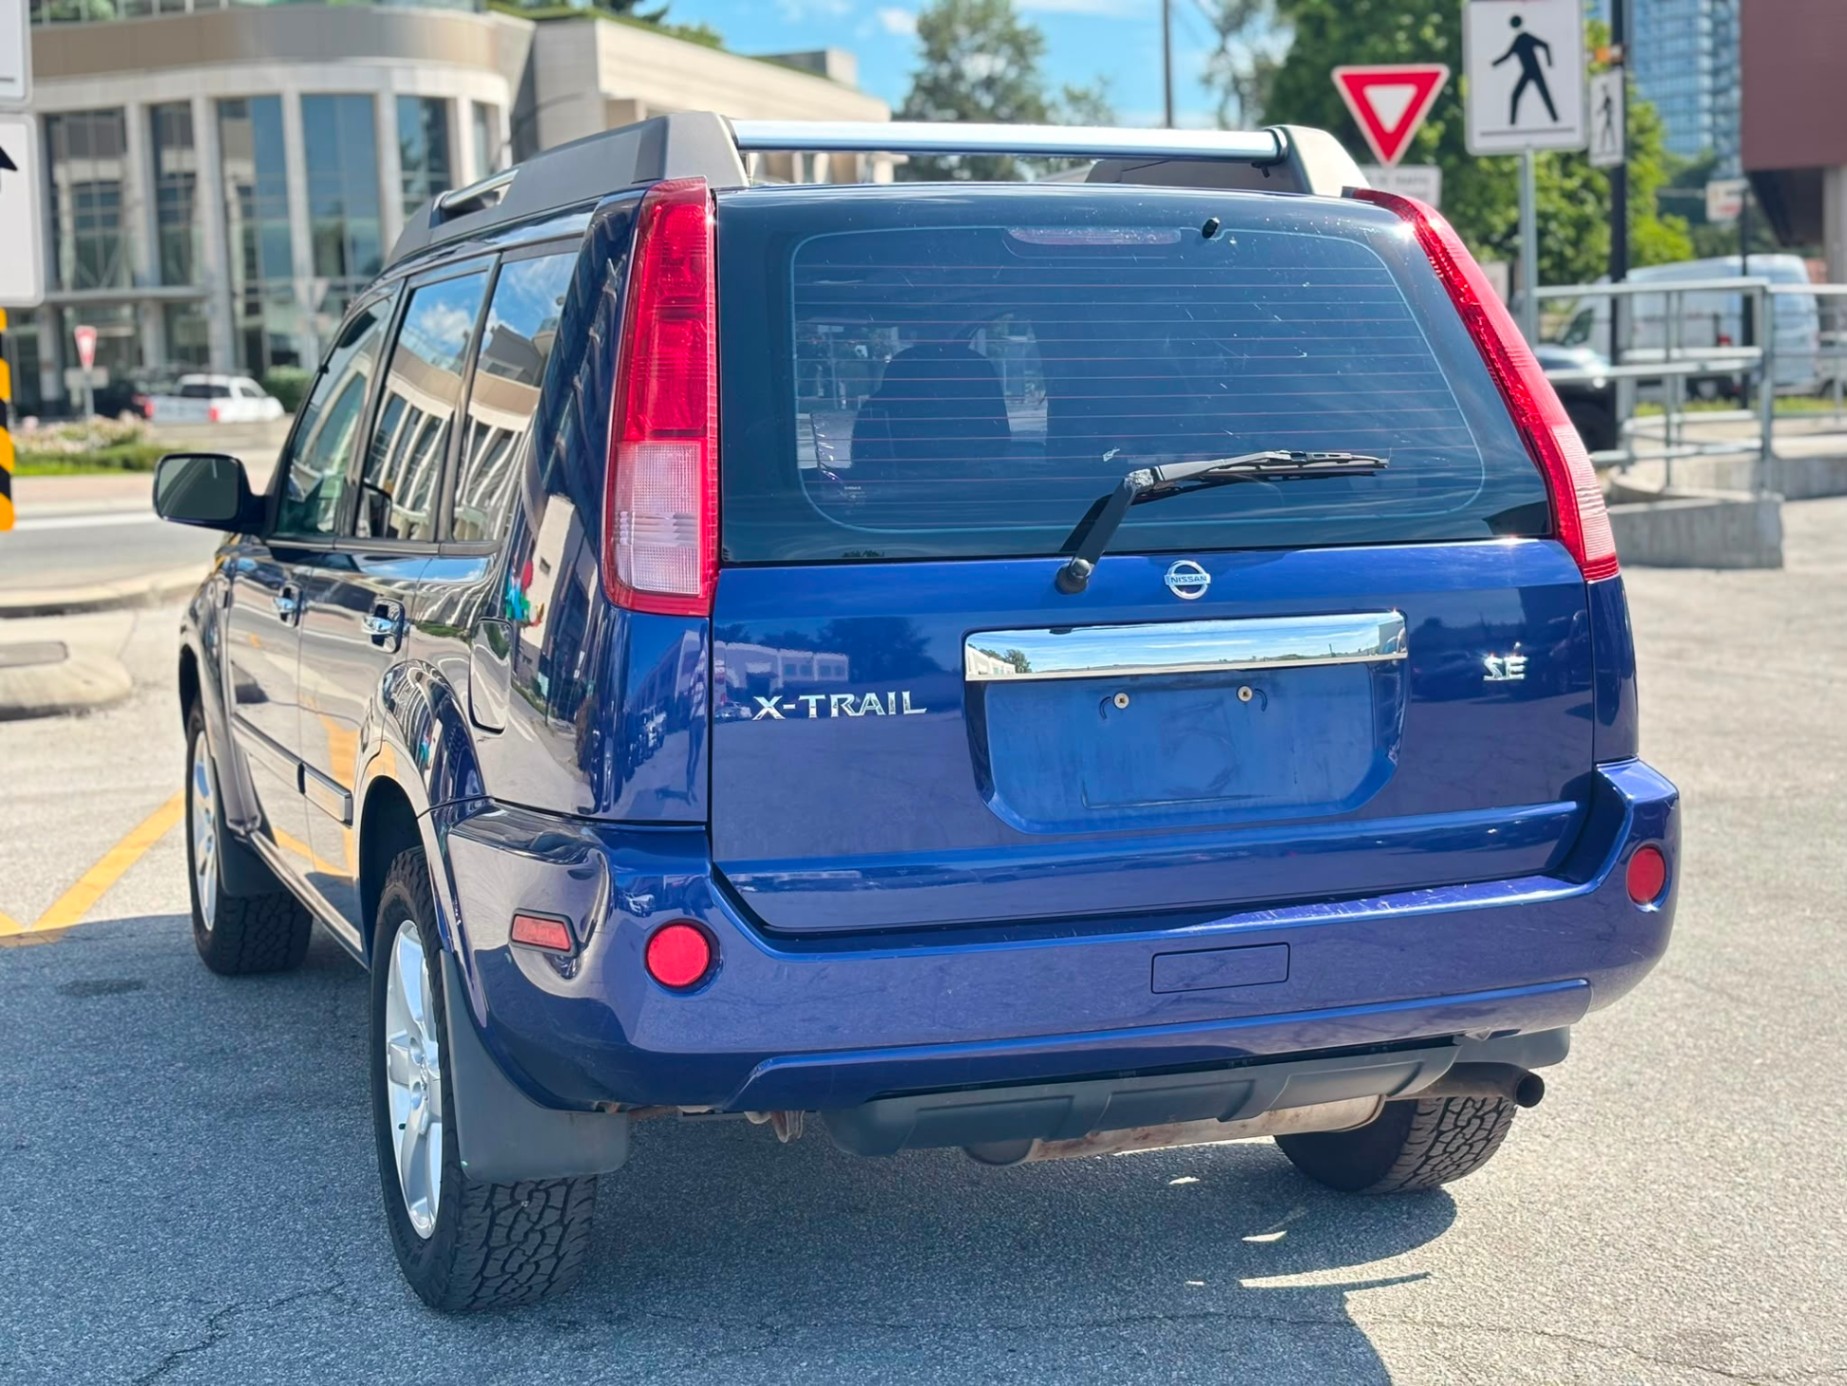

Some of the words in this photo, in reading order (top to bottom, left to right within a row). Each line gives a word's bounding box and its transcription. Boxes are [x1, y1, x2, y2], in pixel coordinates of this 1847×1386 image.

[1170, 575, 1207, 584] NISSAN
[1482, 655, 1528, 681] SE
[752, 690, 928, 721] X-TRAIL
